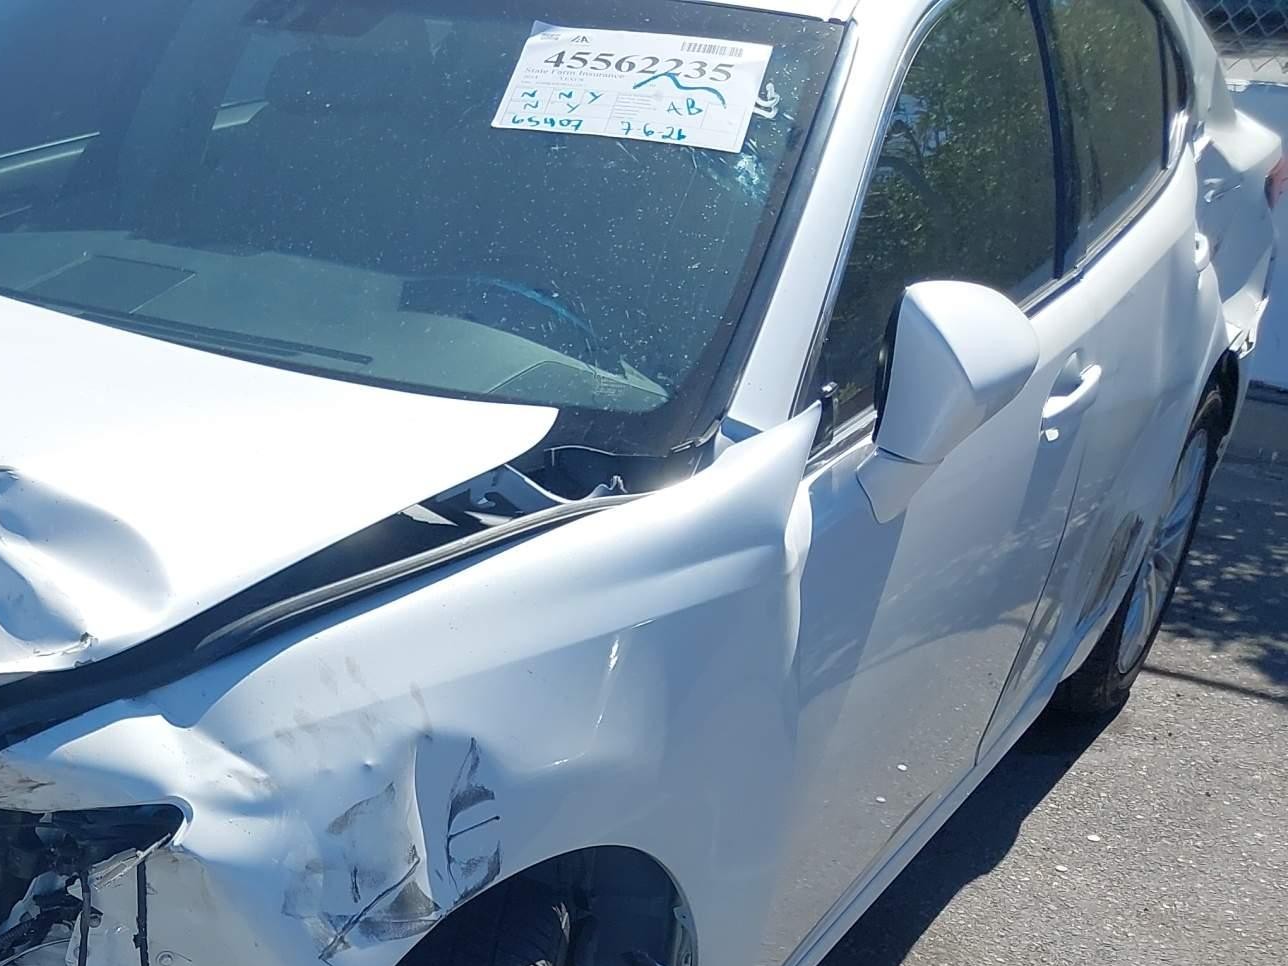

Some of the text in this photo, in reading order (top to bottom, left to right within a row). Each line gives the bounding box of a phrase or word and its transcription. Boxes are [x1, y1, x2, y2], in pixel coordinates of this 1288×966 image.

[524, 66, 626, 80] State Farm Insurance
[543, 49, 735, 82] 45562235
